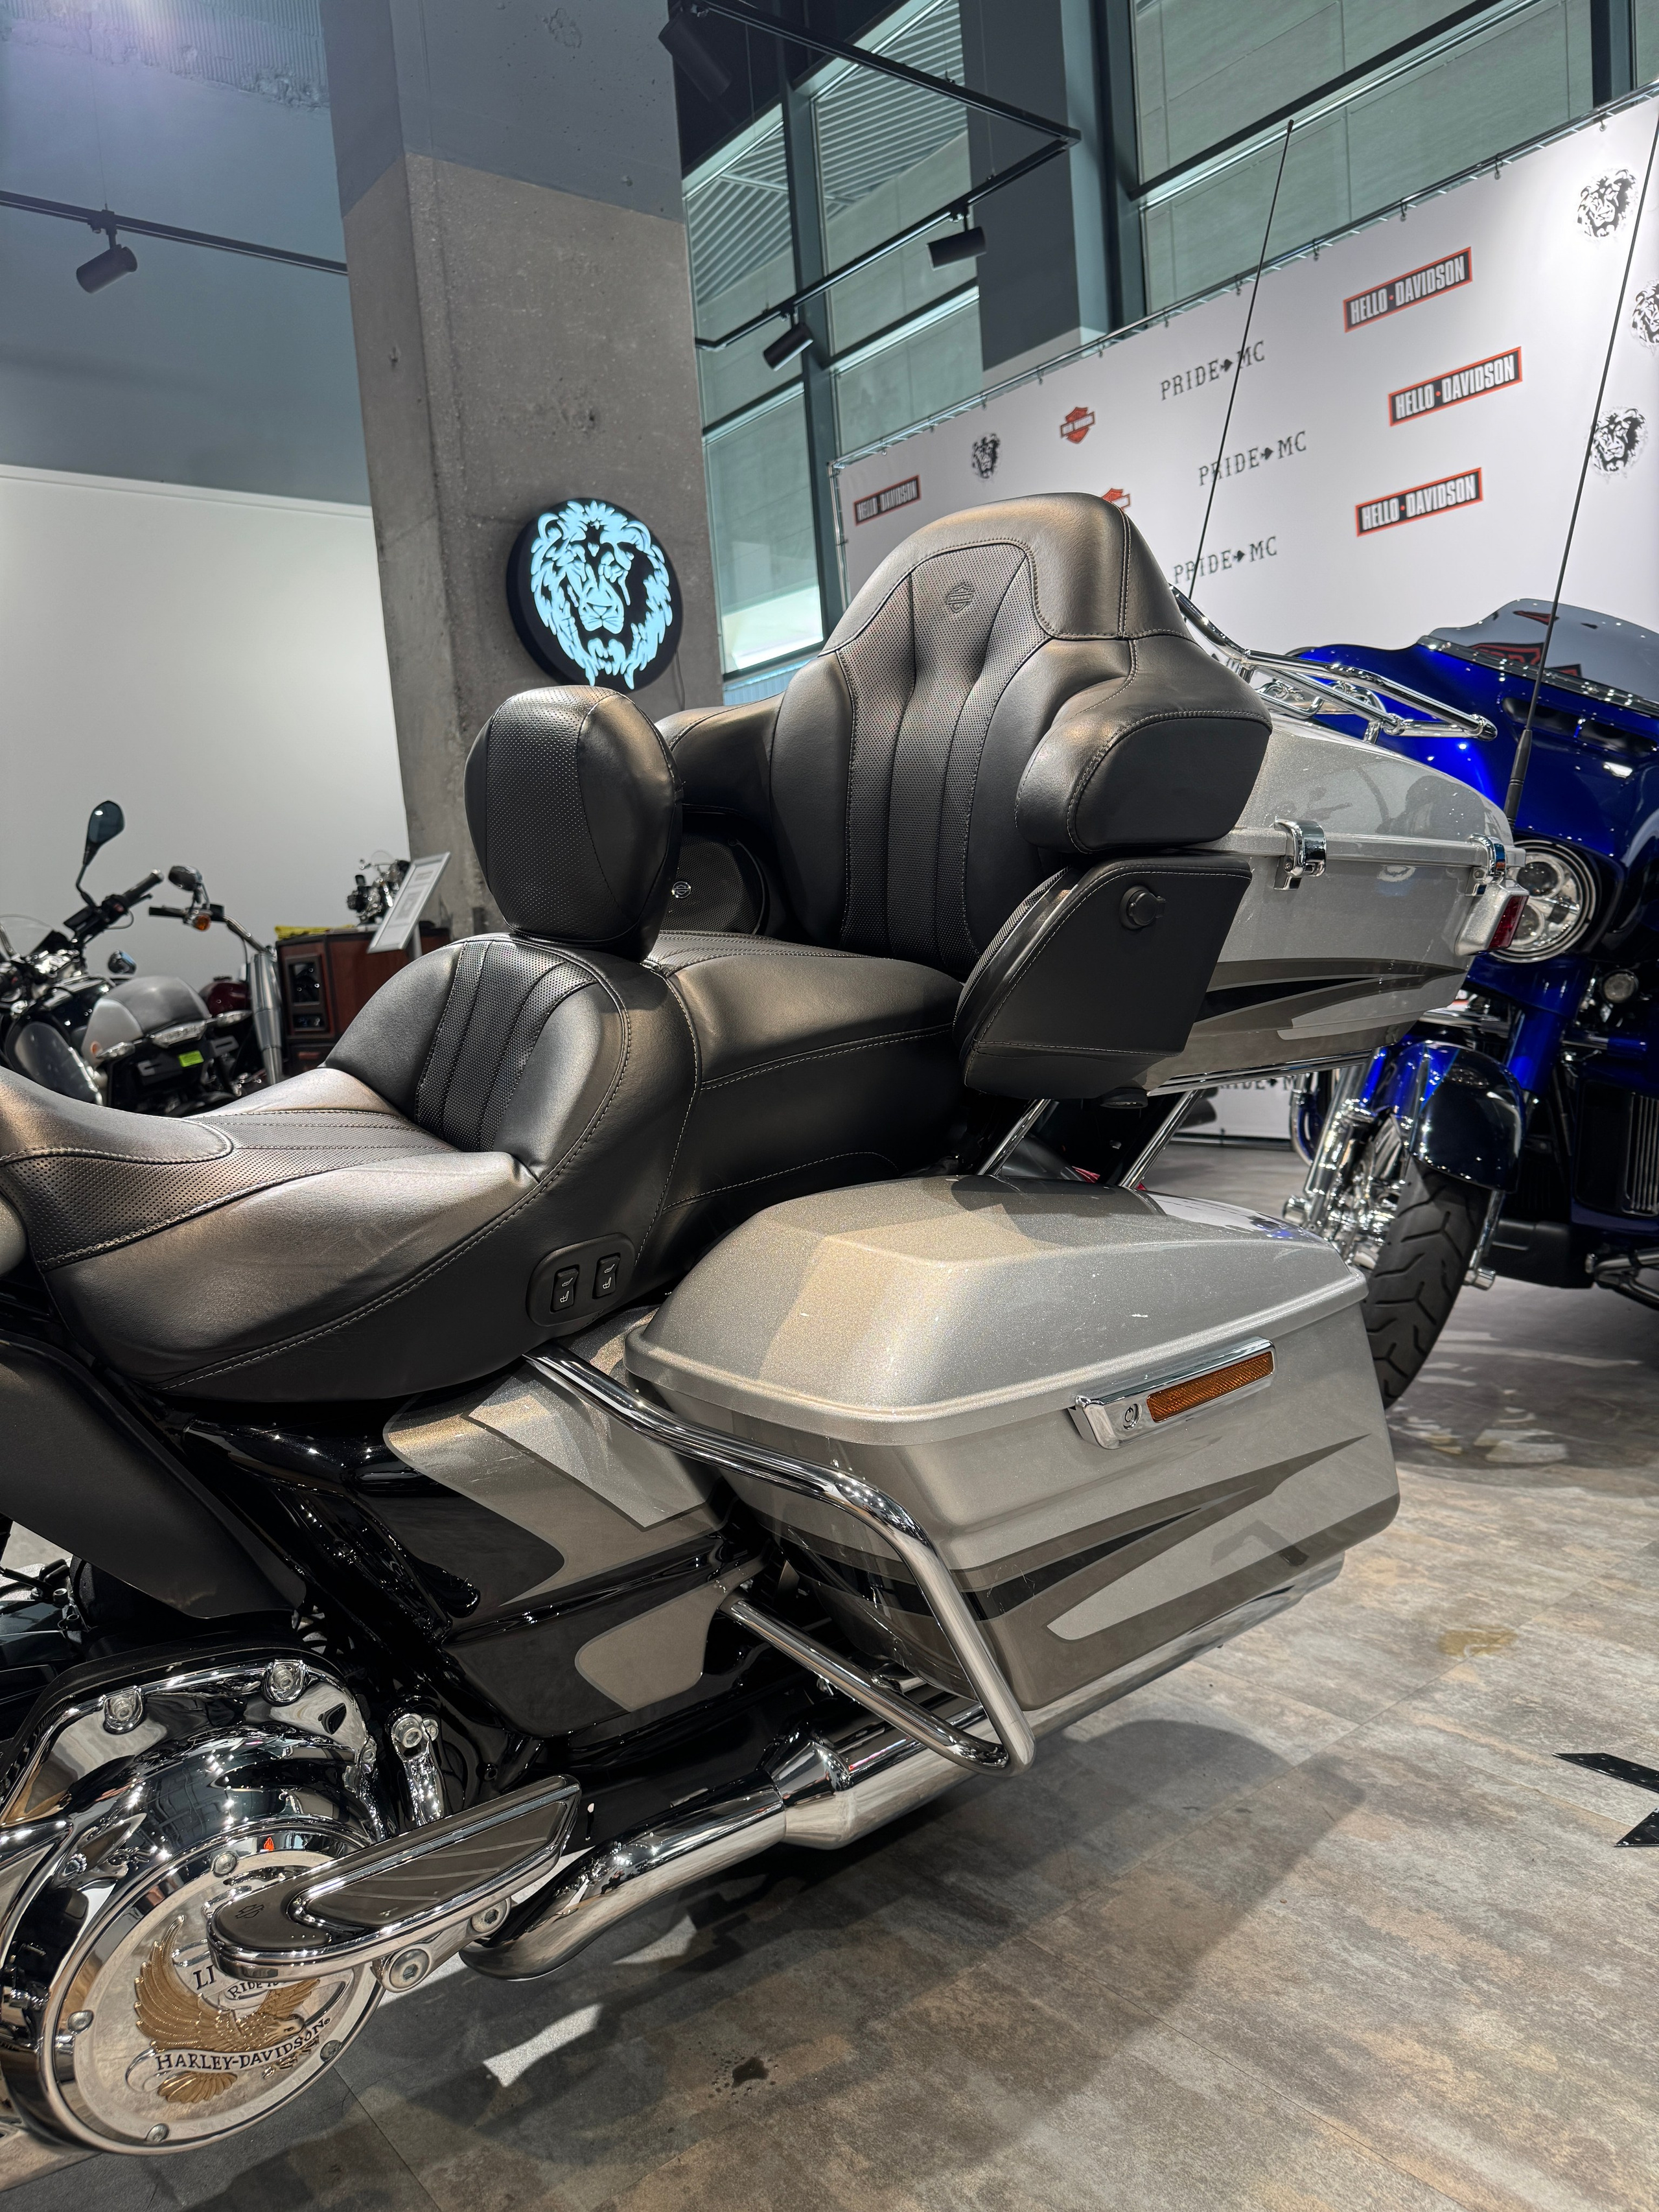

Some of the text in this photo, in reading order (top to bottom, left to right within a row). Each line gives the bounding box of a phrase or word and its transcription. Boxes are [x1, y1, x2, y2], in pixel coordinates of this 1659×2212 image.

[1350, 255, 1465, 325] HELLO DAVIDSON
[1160, 340, 1265, 401] PRIDE MC
[1395, 355, 1515, 419] HELLO DAVIDSON
[1199, 430, 1306, 487] PRIDE MC
[1362, 474, 1476, 531] HELLO DAVIDSON
[1174, 535, 1277, 584] PRIDE MC
